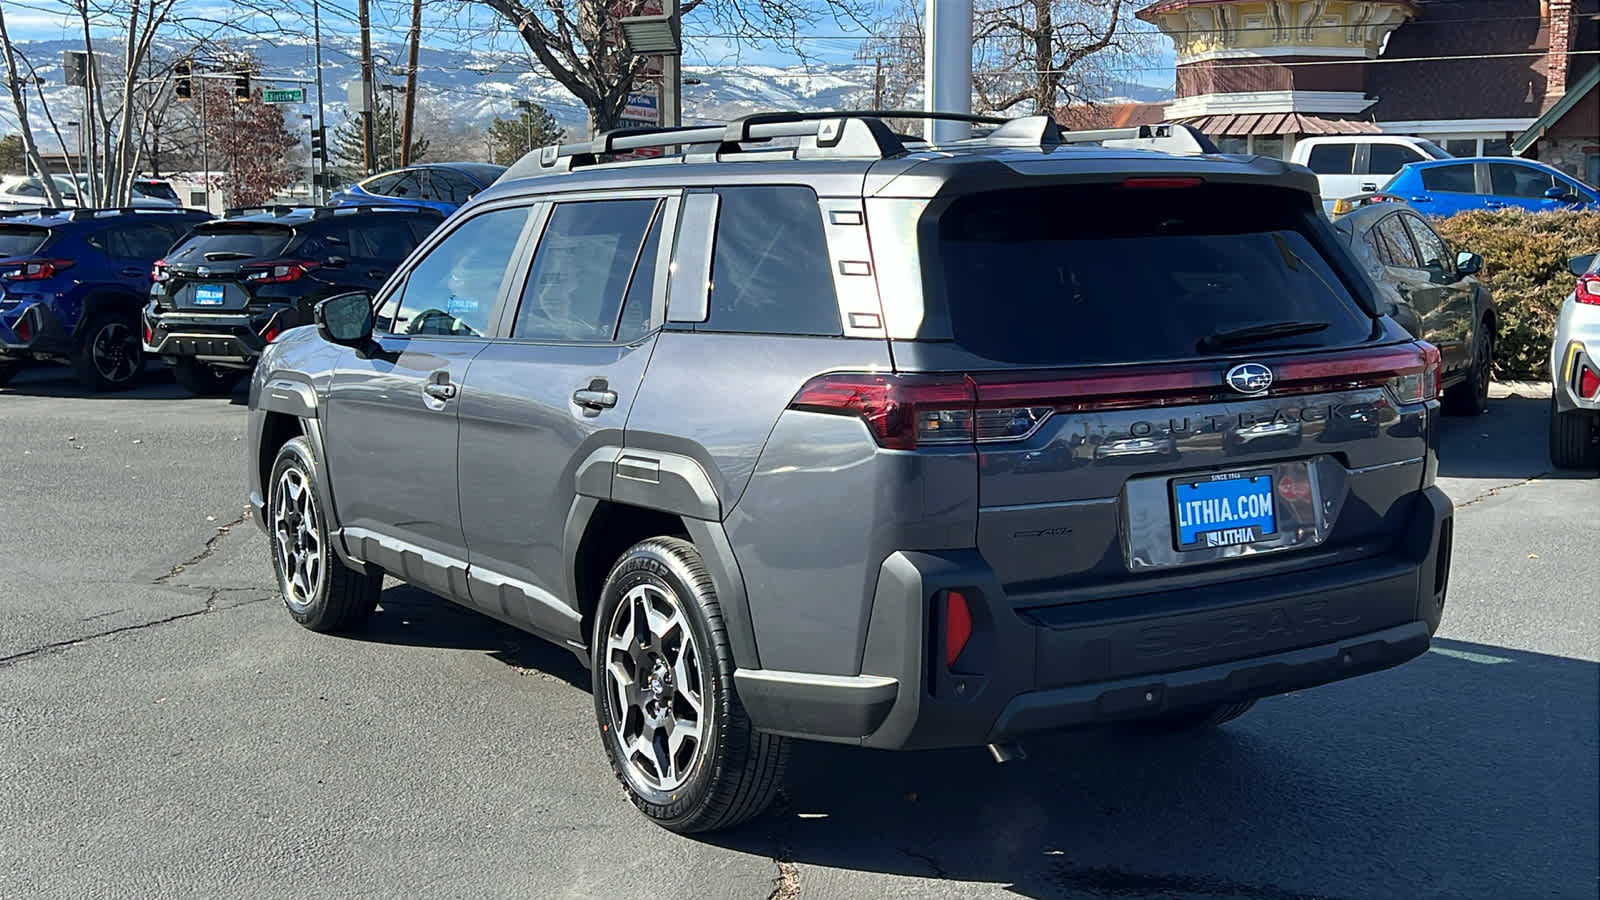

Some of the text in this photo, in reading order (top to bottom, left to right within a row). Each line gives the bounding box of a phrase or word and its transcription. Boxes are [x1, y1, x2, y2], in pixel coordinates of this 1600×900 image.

[1130, 404, 1345, 437] OUTBACK
[1178, 492, 1273, 527] LITHIA.COM
[1217, 528, 1255, 545] LITHIA
